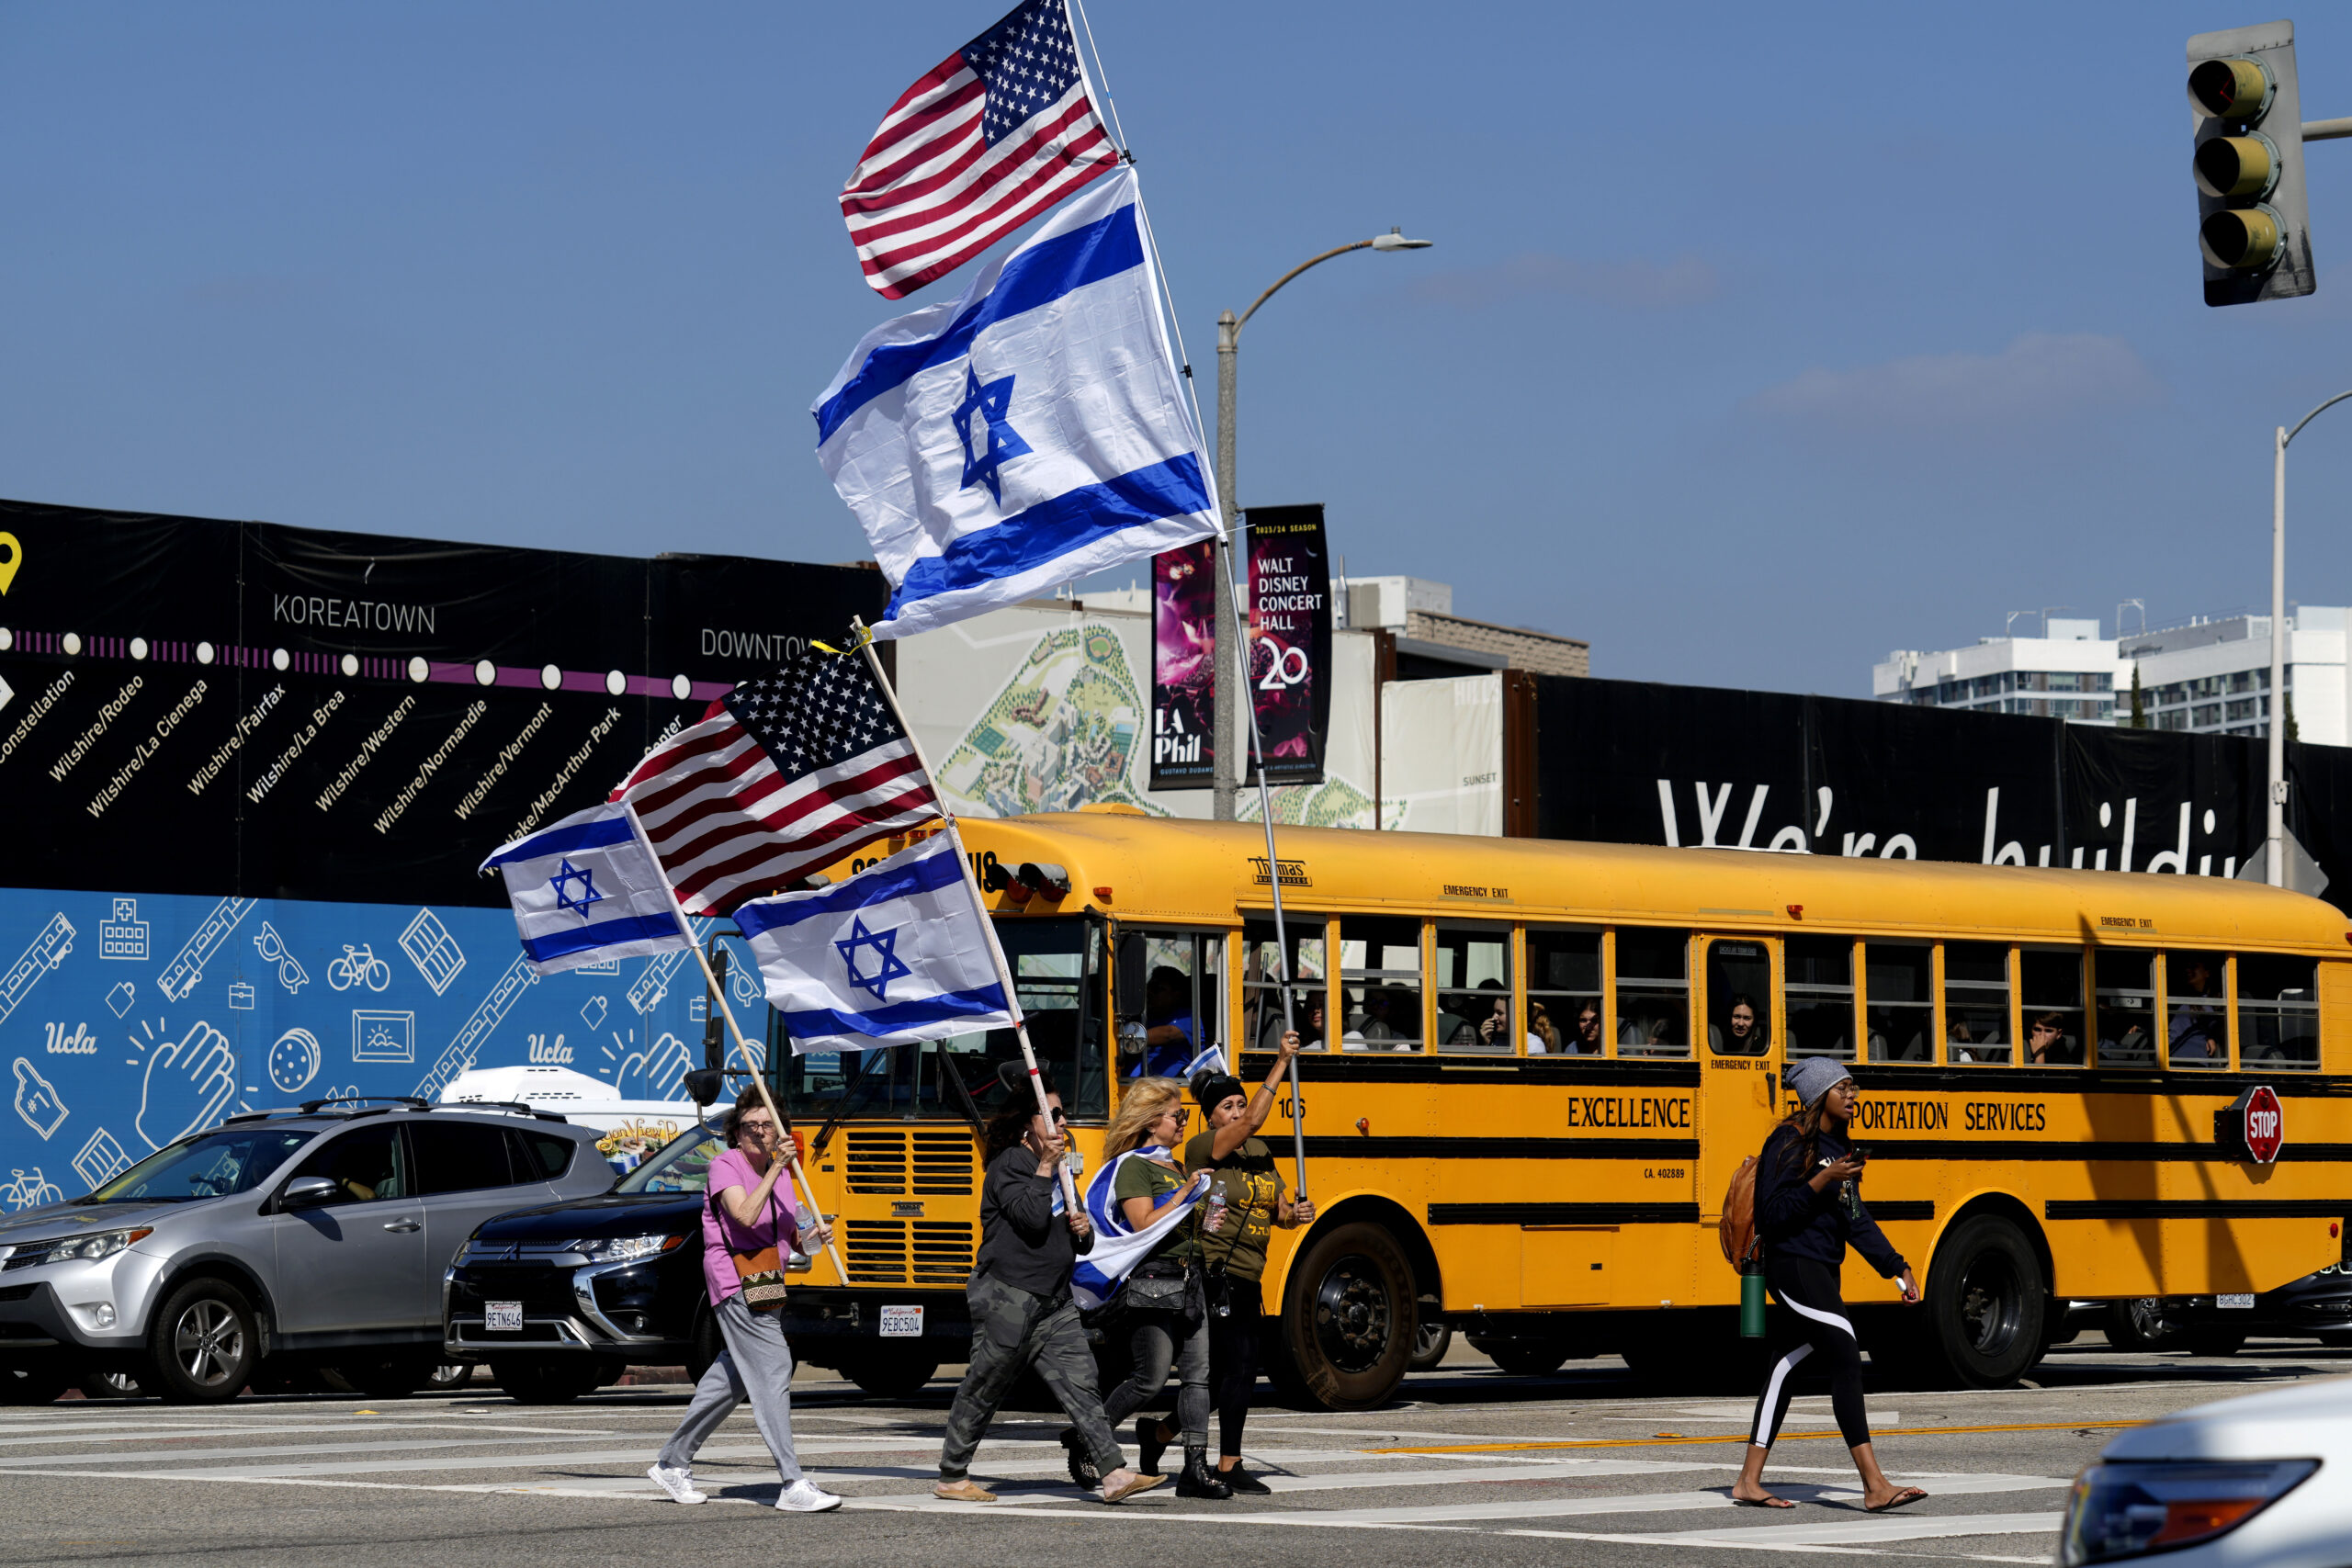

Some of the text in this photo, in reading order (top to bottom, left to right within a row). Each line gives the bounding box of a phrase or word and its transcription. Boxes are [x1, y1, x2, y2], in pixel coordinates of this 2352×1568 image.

[1290, 524, 1317, 533] SEASON
[1258, 558, 1294, 574] WALT
[1259, 576, 1308, 593] DISNEY
[275, 593, 435, 634] KOREATOWN
[1259, 594, 1323, 612] CONCERT
[1260, 615, 1295, 631] HALL
[702, 628, 812, 661] DOWNTO
[1260, 637, 1308, 689] 20
[49, 675, 143, 783] Wilshire/Rodeo
[1156, 708, 1184, 735] LA
[86, 679, 208, 818] Wilshire/La Cienega
[187, 682, 286, 796] Wilshire/Fairfax
[246, 690, 345, 804] Wilshire/La Brea
[1155, 733, 1201, 764] Phil
[315, 694, 416, 813] Wilshire/Western
[373, 700, 487, 834] Wilshire/Normandie
[454, 702, 553, 820] Wilshire/Vermont
[1159, 766, 1214, 776] GUSTAVO DUDAME
[1463, 773, 1497, 787] SUNSET
[484, 739, 594, 877] Wlake/MacArthur
[591, 706, 621, 742] Park
[1248, 856, 1306, 876] Thmas
[1443, 885, 1509, 898] EMERGENCY EXIT
[2100, 916, 2153, 928] EMERGENCY EXIT
[45, 1021, 97, 1055] Ucla
[527, 1033, 574, 1064] Ucla
[1711, 1059, 1770, 1071] EMERGENCY EXIT
[28, 1090, 51, 1114] #1
[1567, 1097, 2046, 1131] EXCELLENCE TPORTATION SERVICES
[2250, 1111, 2278, 1138] STOP
[1644, 1168, 1685, 1179] CA. 402889
[487, 1312, 521, 1326] 9ETN646
[881, 1317, 920, 1332] 9EBC504
